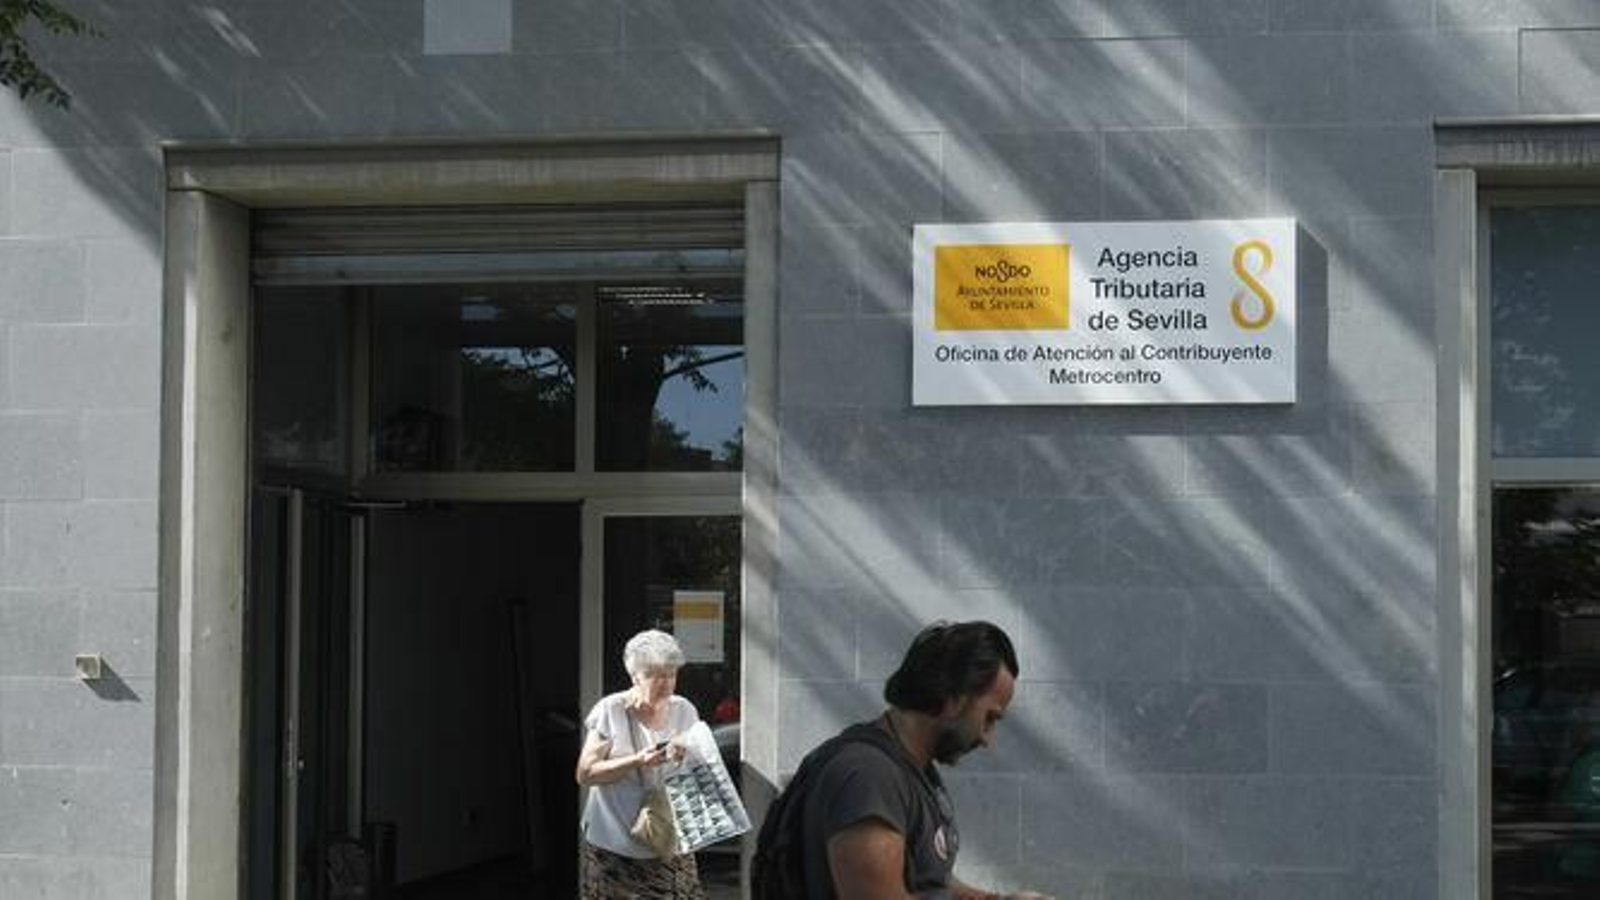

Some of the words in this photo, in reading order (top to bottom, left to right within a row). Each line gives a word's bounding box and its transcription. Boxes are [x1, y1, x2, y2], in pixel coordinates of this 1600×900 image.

[1097, 247, 1199, 272] Agencia
[957, 284, 1050, 299] AYUNTAMIENTO
[1089, 278, 1206, 299] Tributaria
[1088, 310, 1120, 331] de
[1127, 308, 1208, 331] Sevilla
[935, 345, 999, 362] Oficina
[1004, 345, 1027, 362] de
[1032, 344, 1114, 362] Atención
[1121, 344, 1136, 361] al
[1141, 344, 1272, 364] Contribuyente
[1049, 368, 1162, 385] Metrocentro
